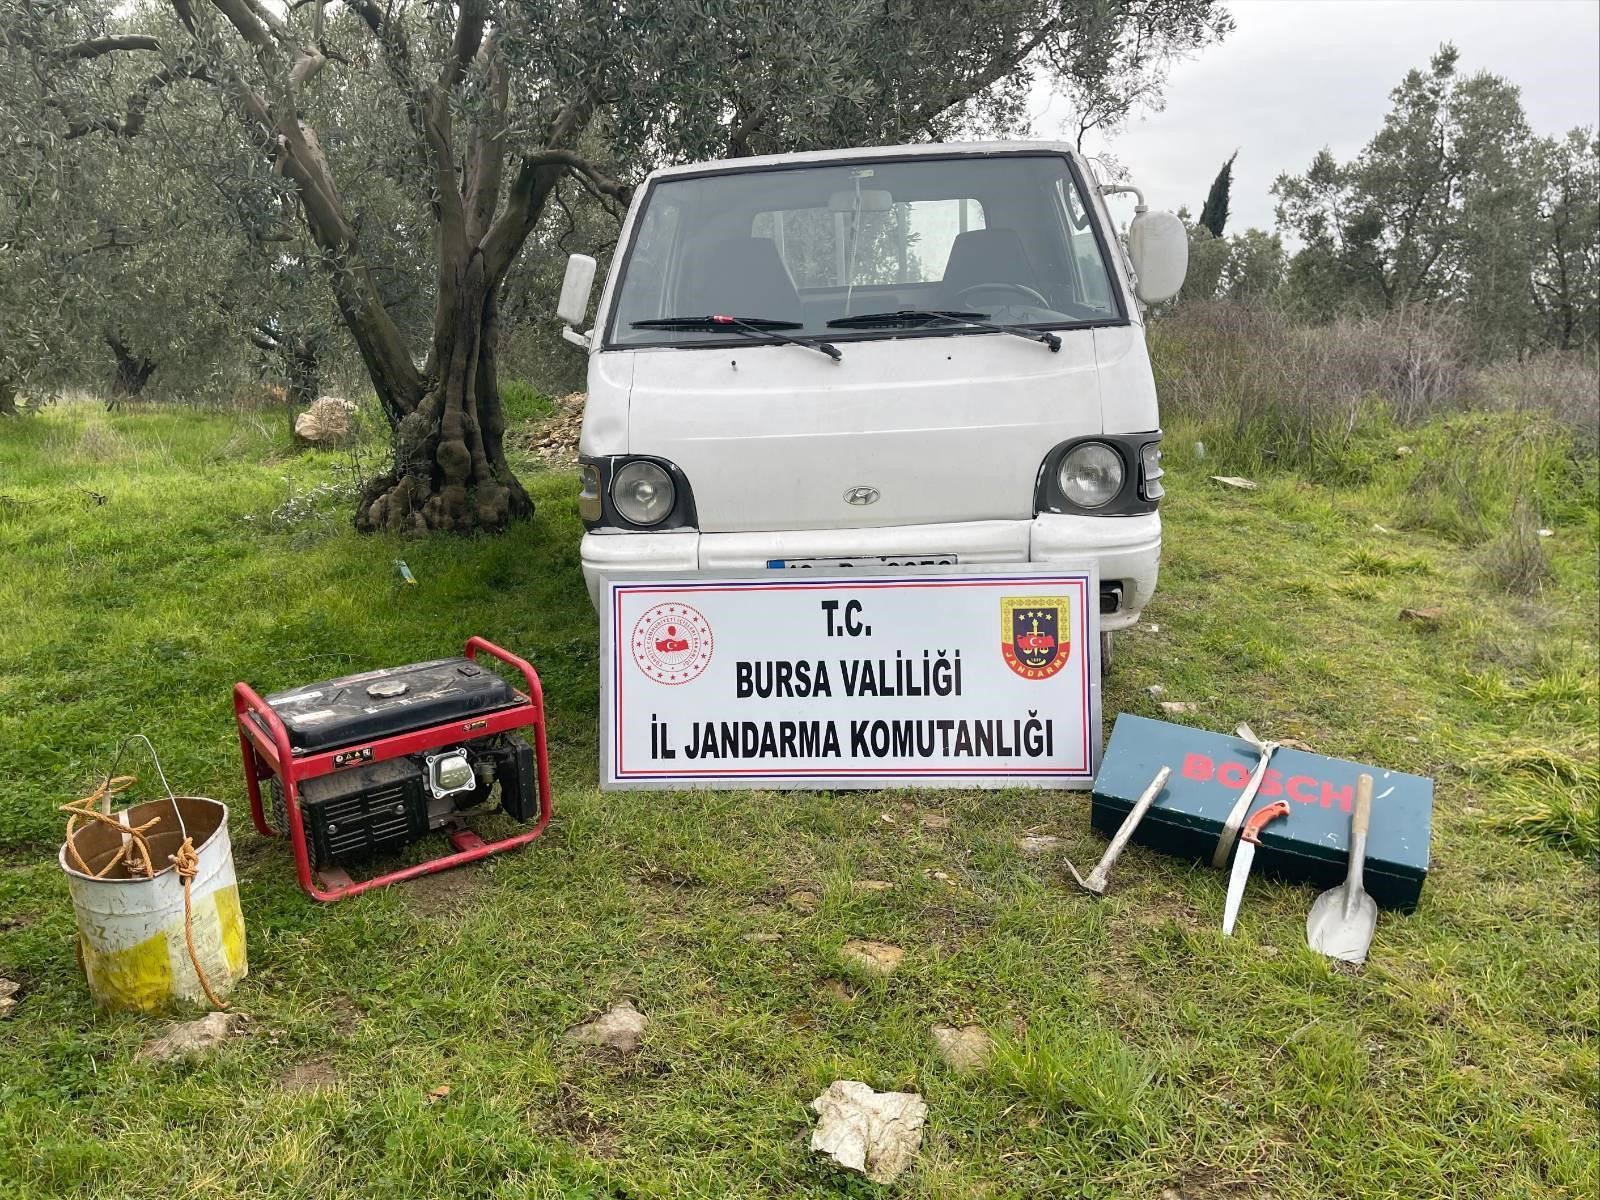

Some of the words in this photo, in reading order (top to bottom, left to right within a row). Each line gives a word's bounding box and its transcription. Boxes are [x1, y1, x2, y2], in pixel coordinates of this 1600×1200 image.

[822, 599, 872, 637] T.C.
[736, 660, 831, 698] BURSA
[840, 650, 961, 697] VALİLİĞİ
[1005, 651, 1067, 677] JANDARMA
[651, 713, 675, 760] İL
[684, 721, 841, 760] JANDARMA
[850, 710, 1054, 758] KOMUTANLIĞI
[1182, 752, 1353, 813] BOSCH
